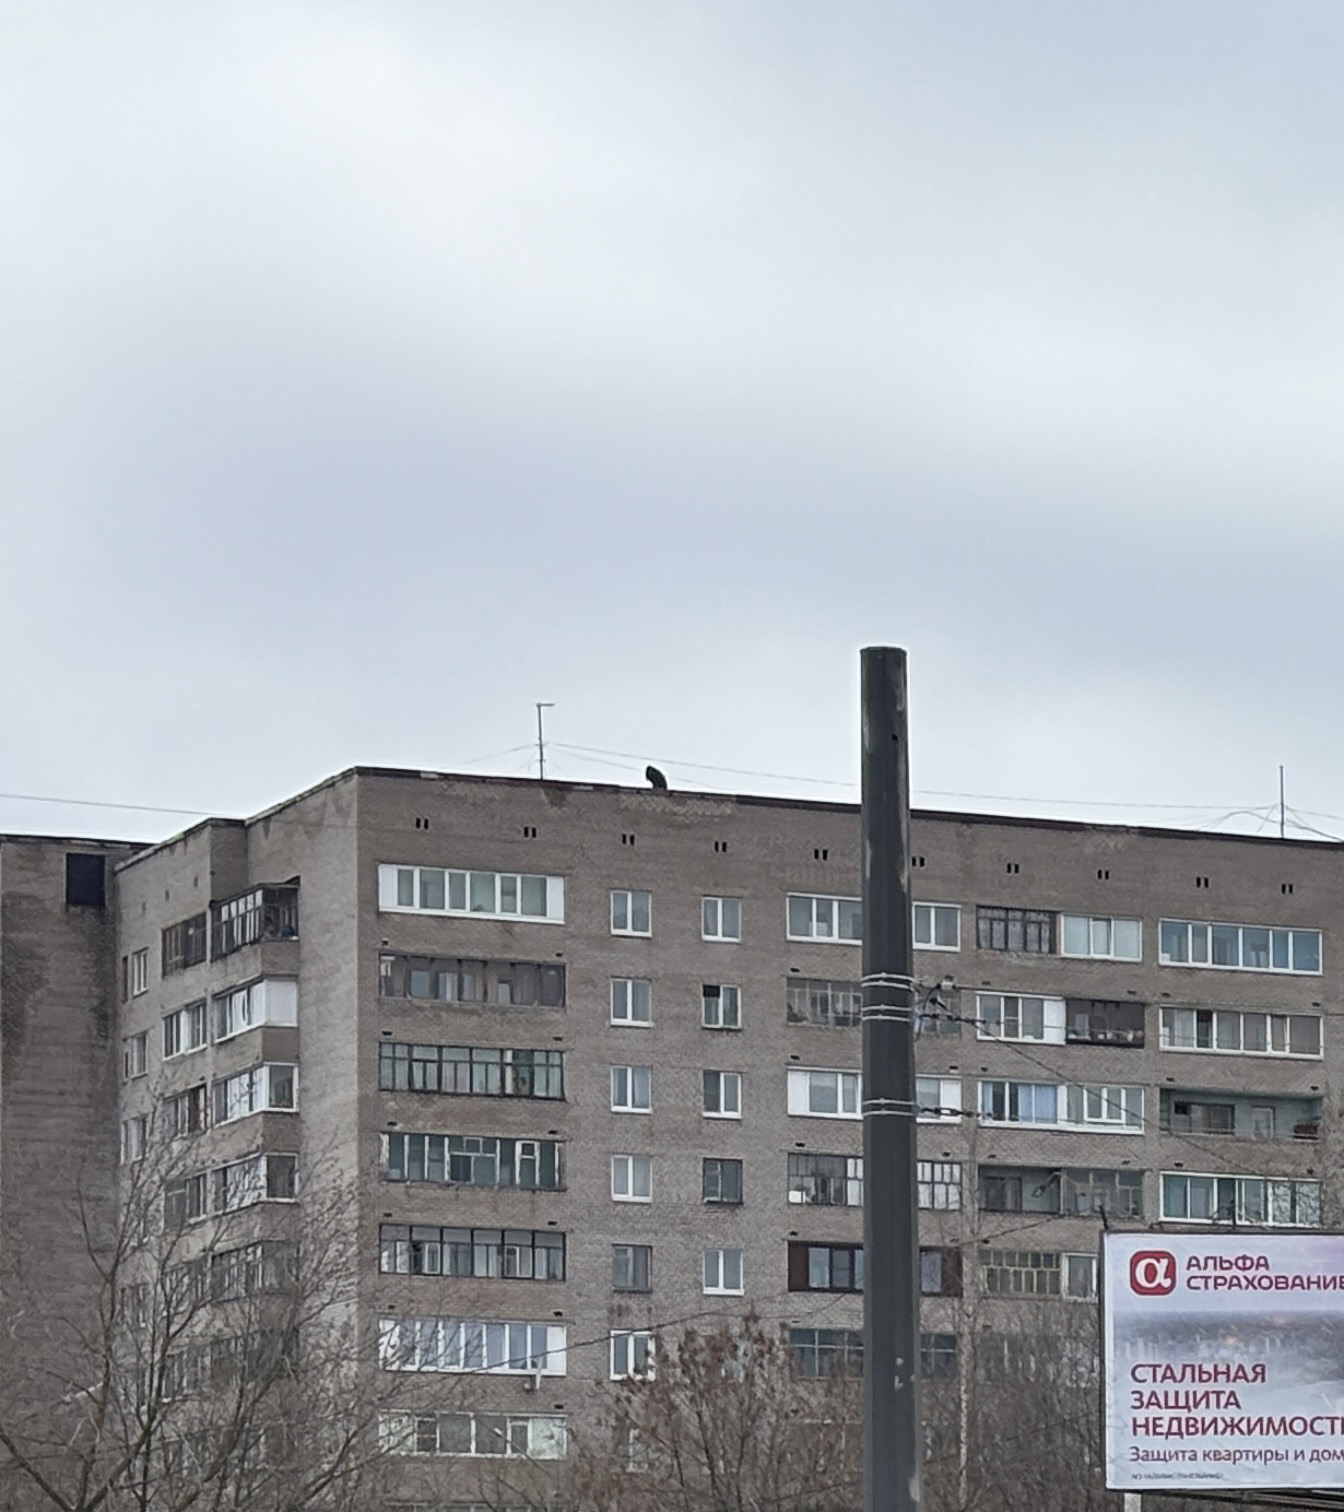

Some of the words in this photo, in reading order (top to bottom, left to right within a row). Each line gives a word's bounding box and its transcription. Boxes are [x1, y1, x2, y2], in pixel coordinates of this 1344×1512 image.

[1186, 1254, 1270, 1271] АЛЬФА
[1130, 1363, 1267, 1384] СТАЛЬНАЯ
[1130, 1390, 1242, 1413] ЗАЩИТА
[1129, 1446, 1198, 1463] Защита
[1202, 1449, 1290, 1465] квартиры
[1294, 1450, 1305, 1462] и
